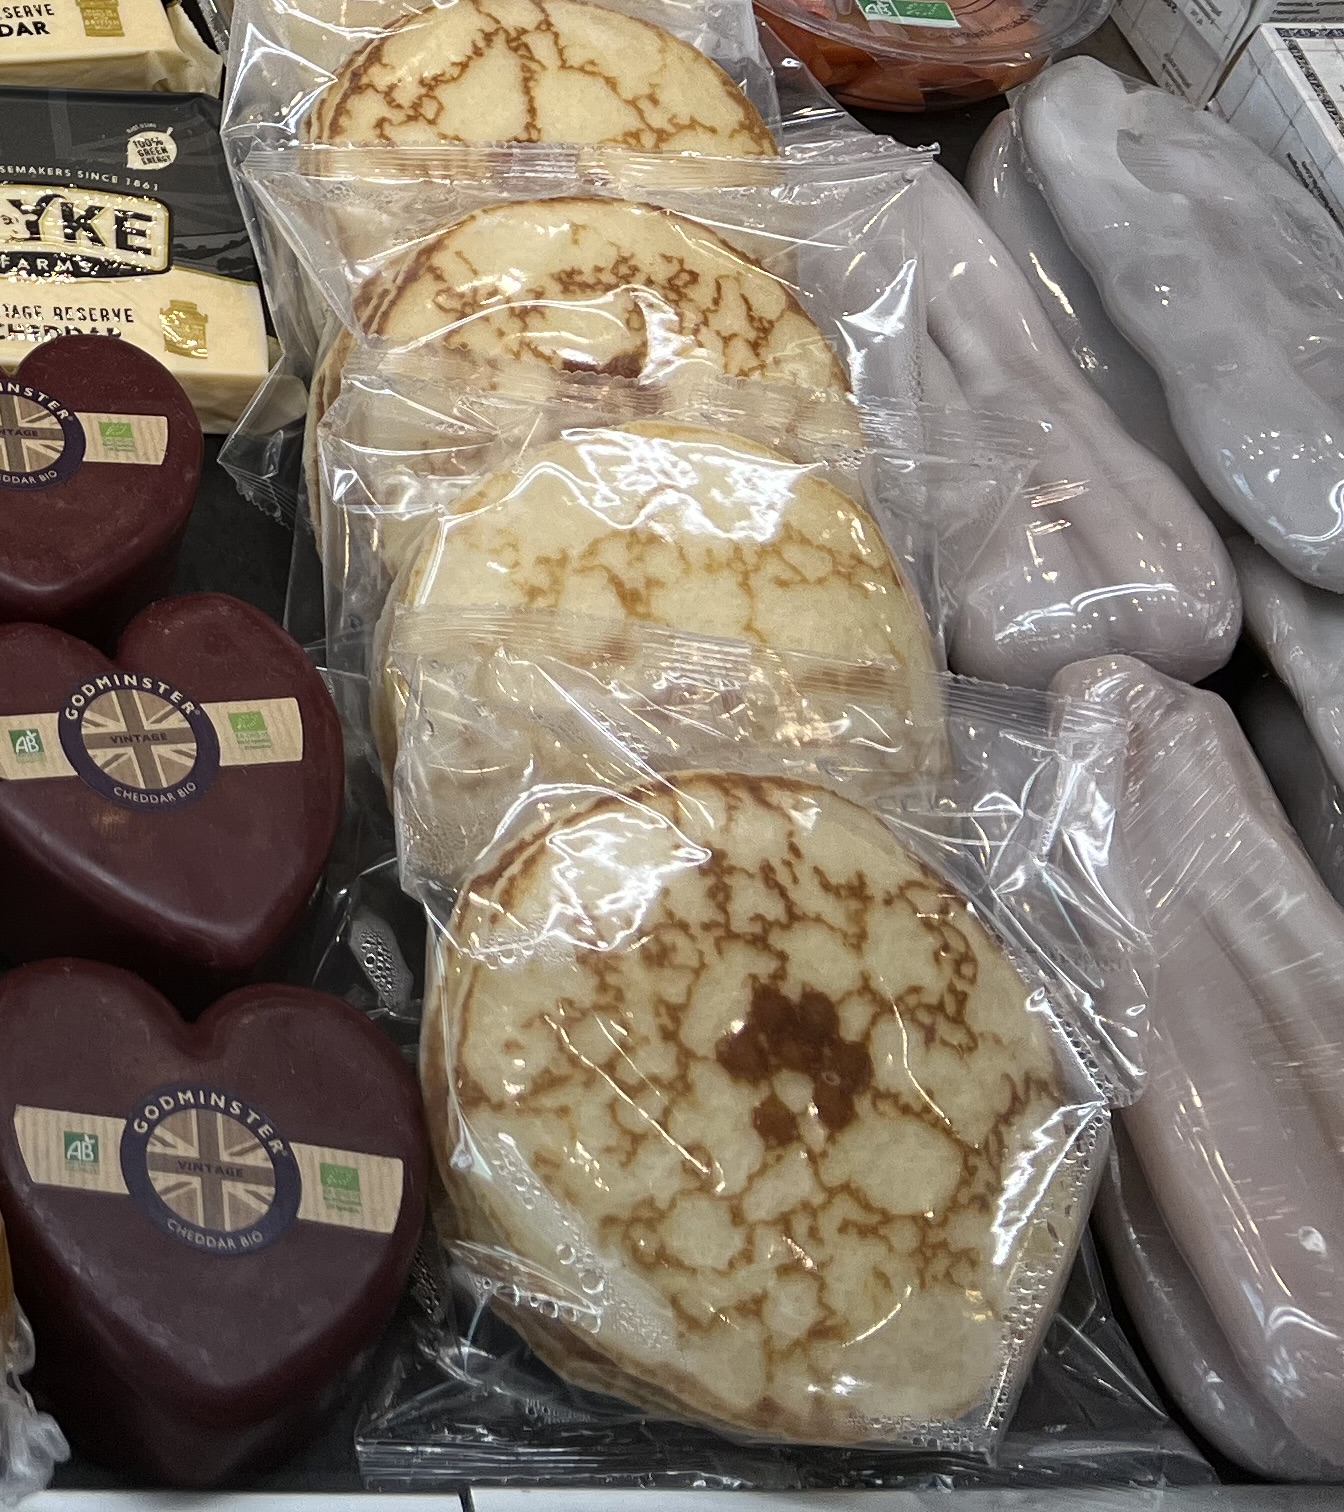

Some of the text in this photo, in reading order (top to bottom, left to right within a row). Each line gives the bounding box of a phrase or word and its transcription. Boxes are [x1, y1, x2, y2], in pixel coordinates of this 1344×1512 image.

[77, 170, 119, 185] SINCE
[125, 177, 160, 192] 1861
[0, 256, 91, 274] FARMS
[52, 306, 135, 324] RESERVE
[38, 469, 59, 483] BIO
[65, 673, 197, 721] GODMINSTER
[109, 732, 168, 744] VINTAGE
[113, 781, 197, 804] CHEDDAR BIO
[132, 1089, 287, 1157] GODMINSTER
[177, 1159, 246, 1179] VINTAGE
[166, 1217, 264, 1251] CHEDDAR BIO
